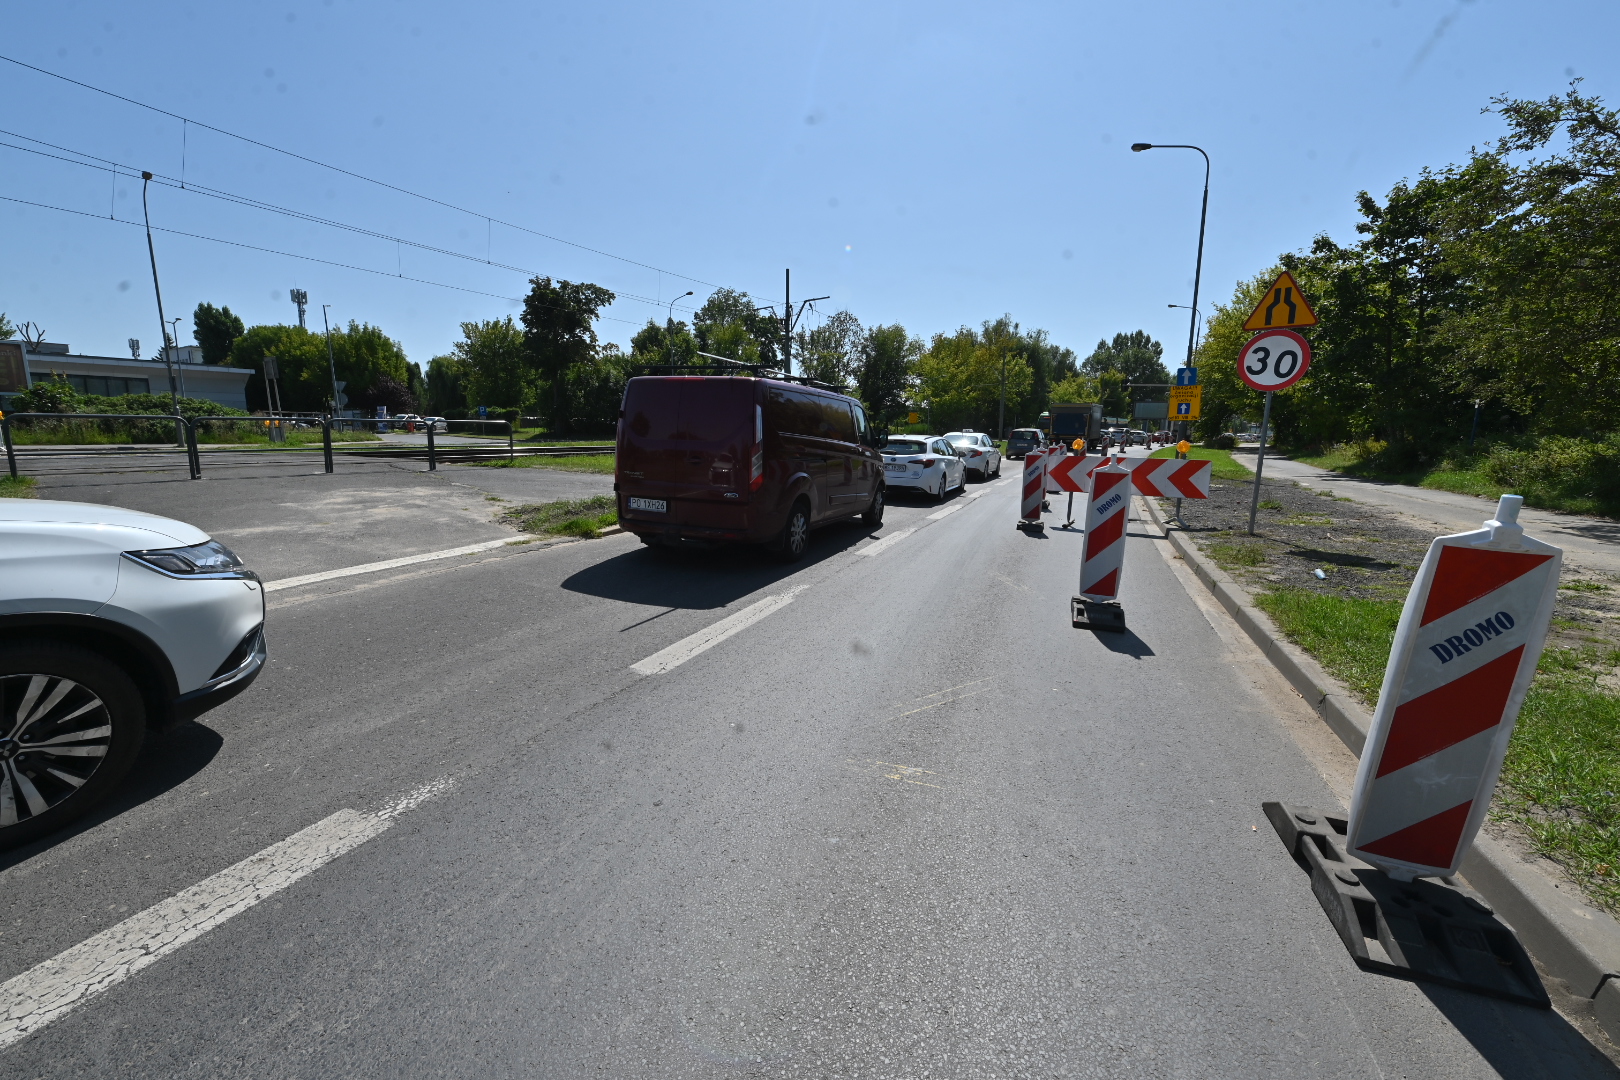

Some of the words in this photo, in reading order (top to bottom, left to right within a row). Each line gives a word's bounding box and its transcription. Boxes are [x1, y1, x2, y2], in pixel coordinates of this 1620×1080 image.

[1246, 347, 1298, 378] 30
[643, 499, 665, 510] 1XH26
[1096, 494, 1121, 515] DROMO
[1429, 611, 1515, 664] DROMO
